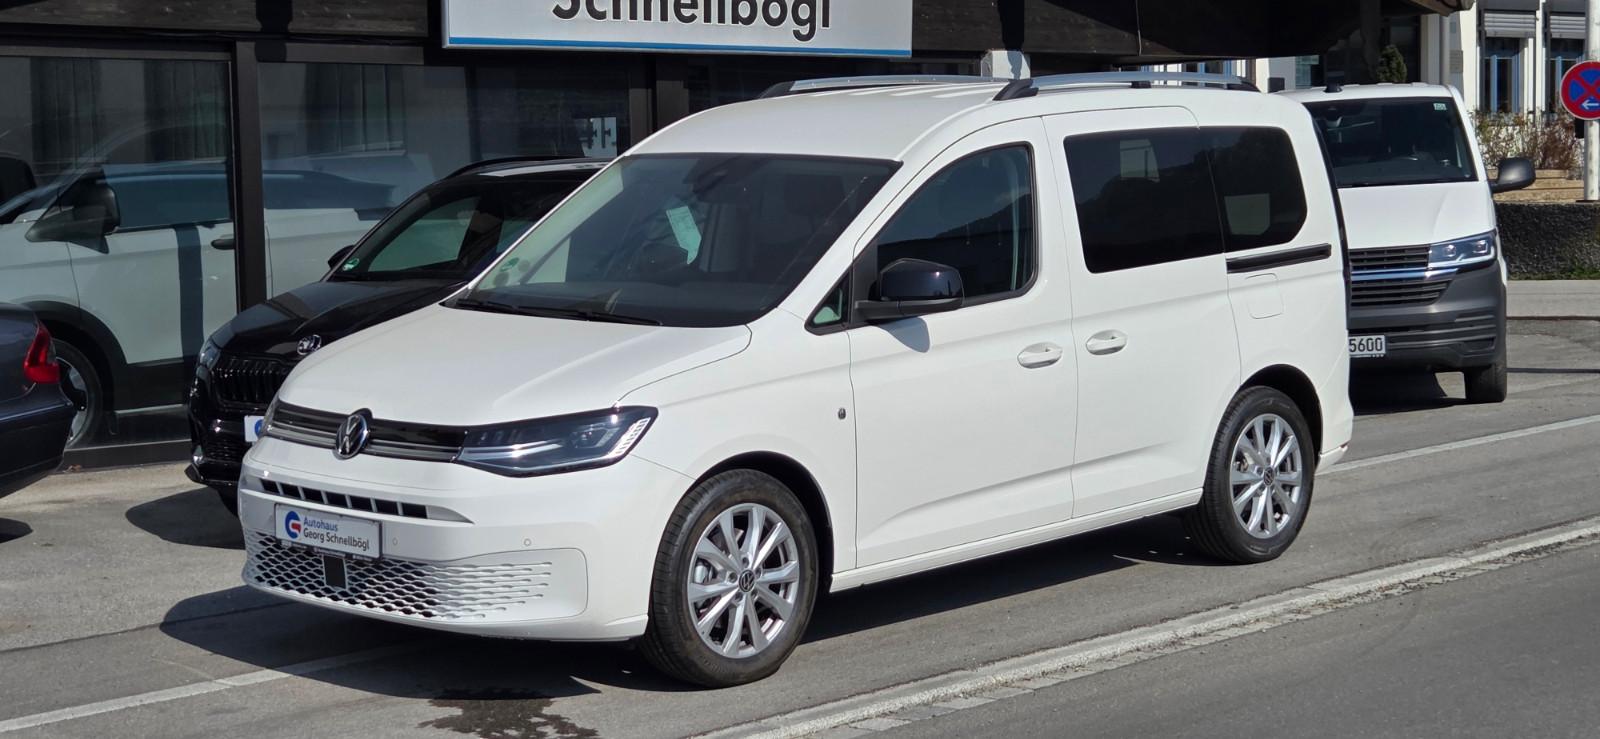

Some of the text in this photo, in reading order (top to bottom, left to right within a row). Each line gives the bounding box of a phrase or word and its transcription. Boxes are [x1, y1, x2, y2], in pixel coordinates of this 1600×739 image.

[1349, 337, 1383, 353] 5600
[303, 517, 338, 532] Autohaus
[303, 528, 370, 551] Georg Schnellbögl
